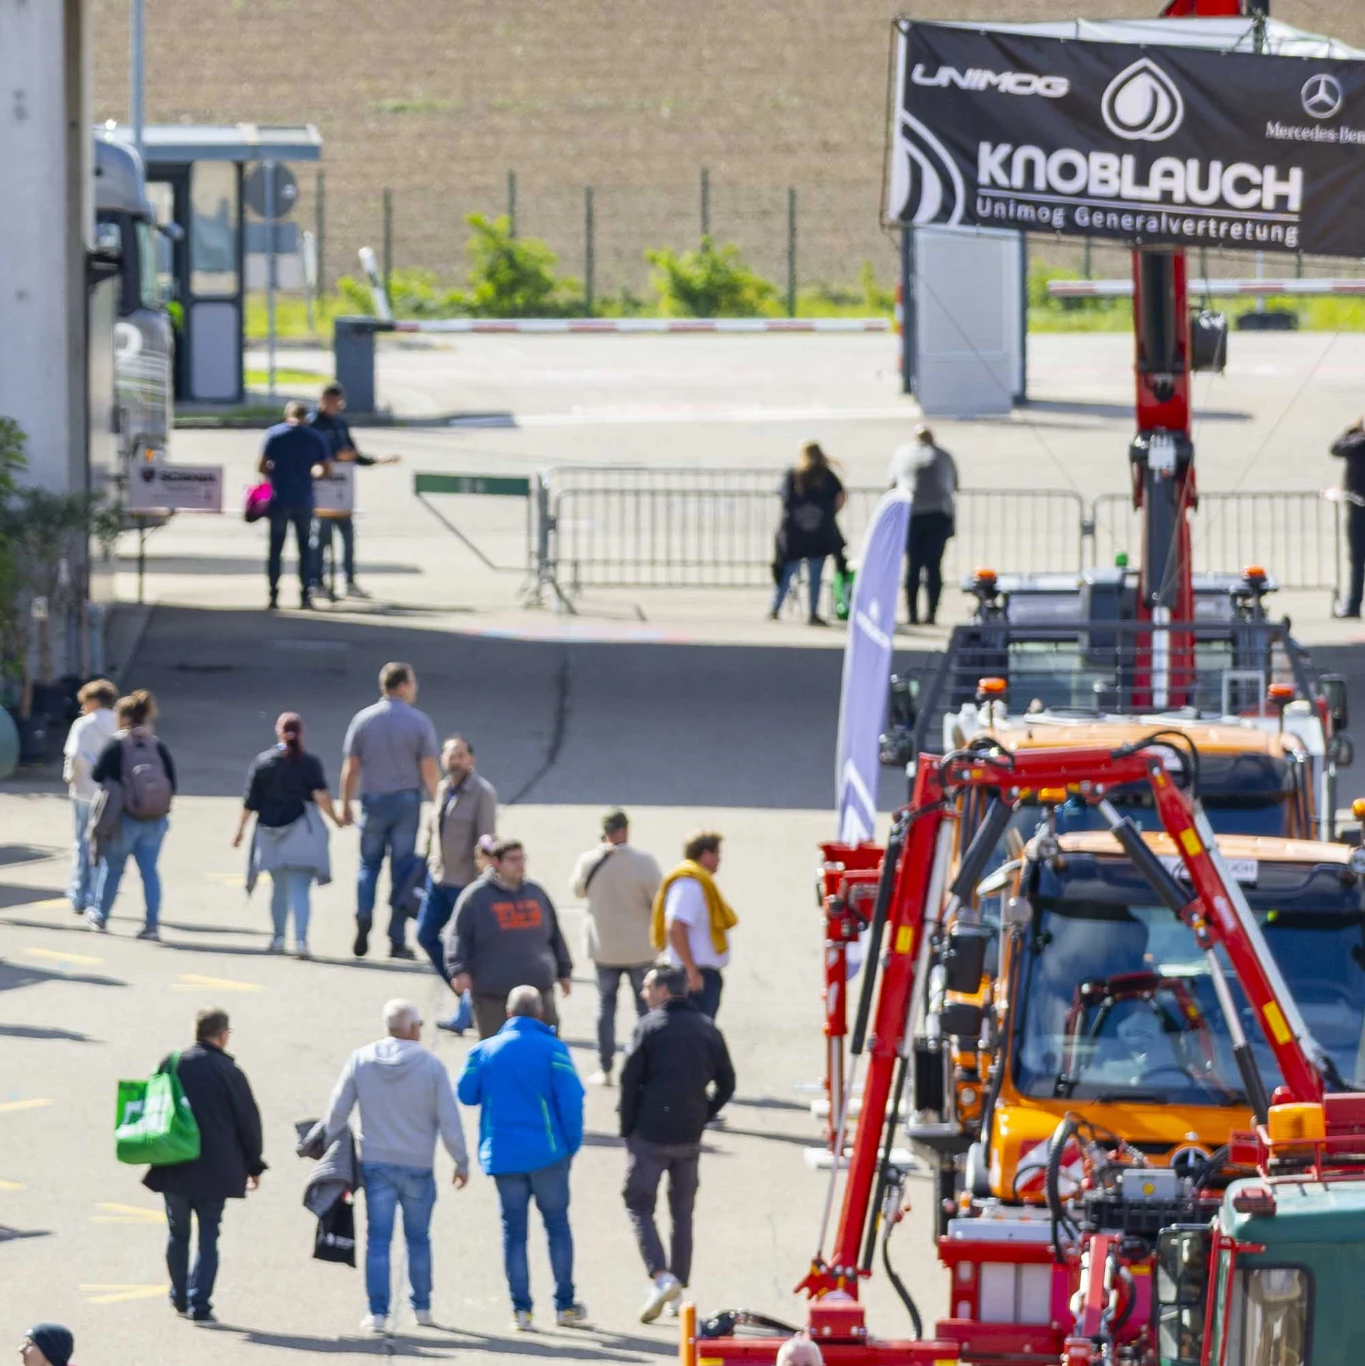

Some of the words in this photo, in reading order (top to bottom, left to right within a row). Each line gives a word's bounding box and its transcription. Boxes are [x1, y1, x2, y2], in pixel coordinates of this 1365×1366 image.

[911, 63, 1070, 98] UNIMOG
[1265, 120, 1365, 145] Mercedes-Ben
[977, 140, 1303, 212] KNOBLAUCH
[976, 195, 1065, 229] Unimog
[1073, 205, 1299, 248] Generalvertretung
